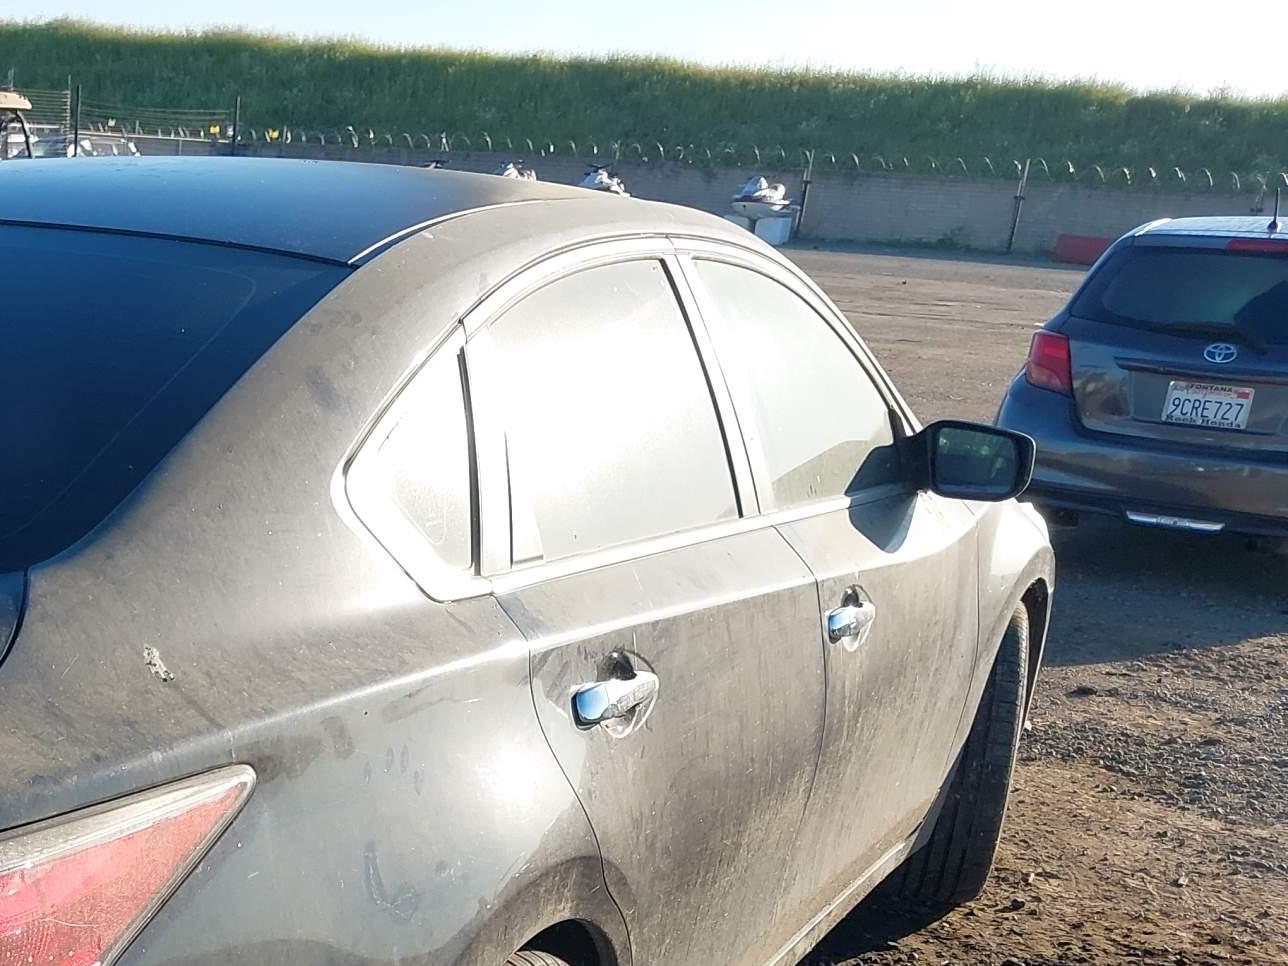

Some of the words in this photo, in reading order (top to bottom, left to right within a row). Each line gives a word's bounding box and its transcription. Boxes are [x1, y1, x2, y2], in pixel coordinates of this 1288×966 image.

[1190, 383, 1233, 393] FONTANA
[1168, 397, 1245, 422] 9CRE727
[1200, 419, 1242, 429] Honda
